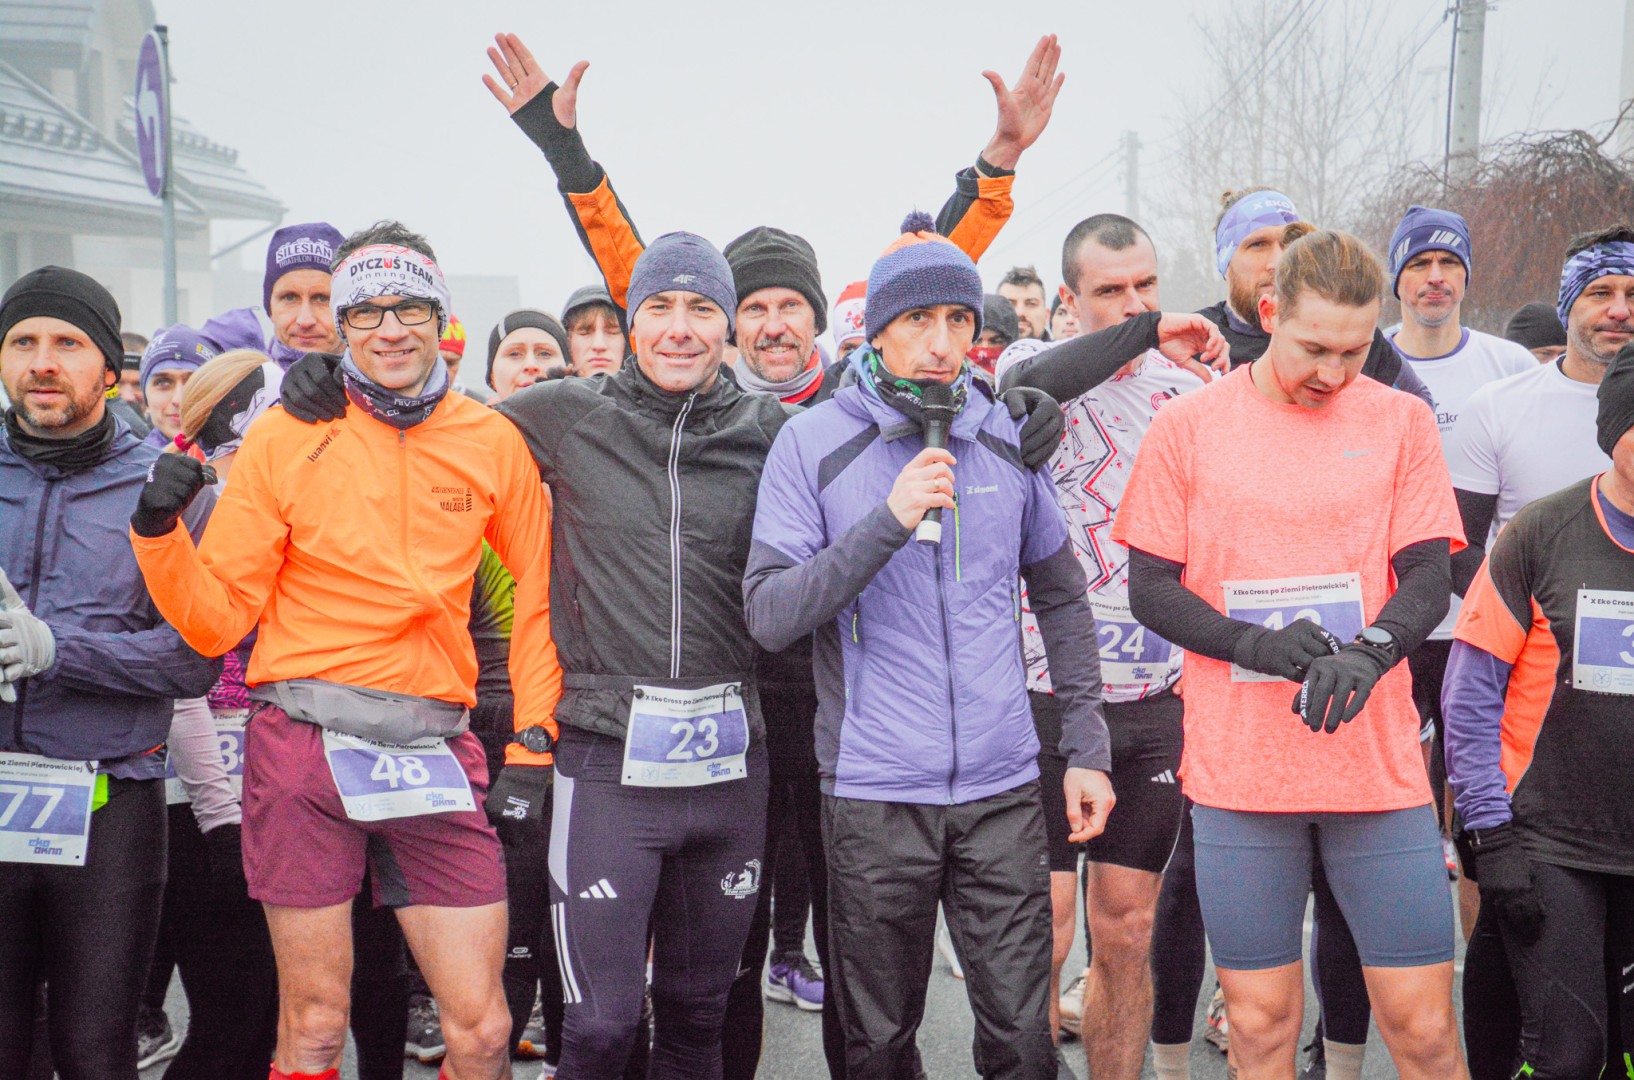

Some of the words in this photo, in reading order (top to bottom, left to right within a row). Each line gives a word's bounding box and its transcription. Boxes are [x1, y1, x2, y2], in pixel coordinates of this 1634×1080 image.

[277, 243, 331, 260] SILESIAN
[278, 255, 312, 268] TRIATHLON
[313, 256, 331, 267] TEAM
[350, 256, 401, 278] DYCZUŚ
[404, 260, 434, 287] TEAM
[351, 270, 406, 285] running
[672, 274, 697, 284] 4F
[307, 434, 333, 463] luanvi
[1270, 588, 1280, 596] po
[1280, 585, 1301, 593] Ziemi
[1302, 581, 1348, 592] Pietrowickiej
[1094, 601, 1112, 610] Cross
[1098, 624, 1145, 660] 24
[651, 695, 663, 703] Eko
[1300, 679, 1310, 708] TERREX
[666, 717, 719, 760] 23
[7, 759, 30, 767] Ziemi
[30, 761, 84, 773] Pietrowickiej
[370, 753, 431, 788] 48
